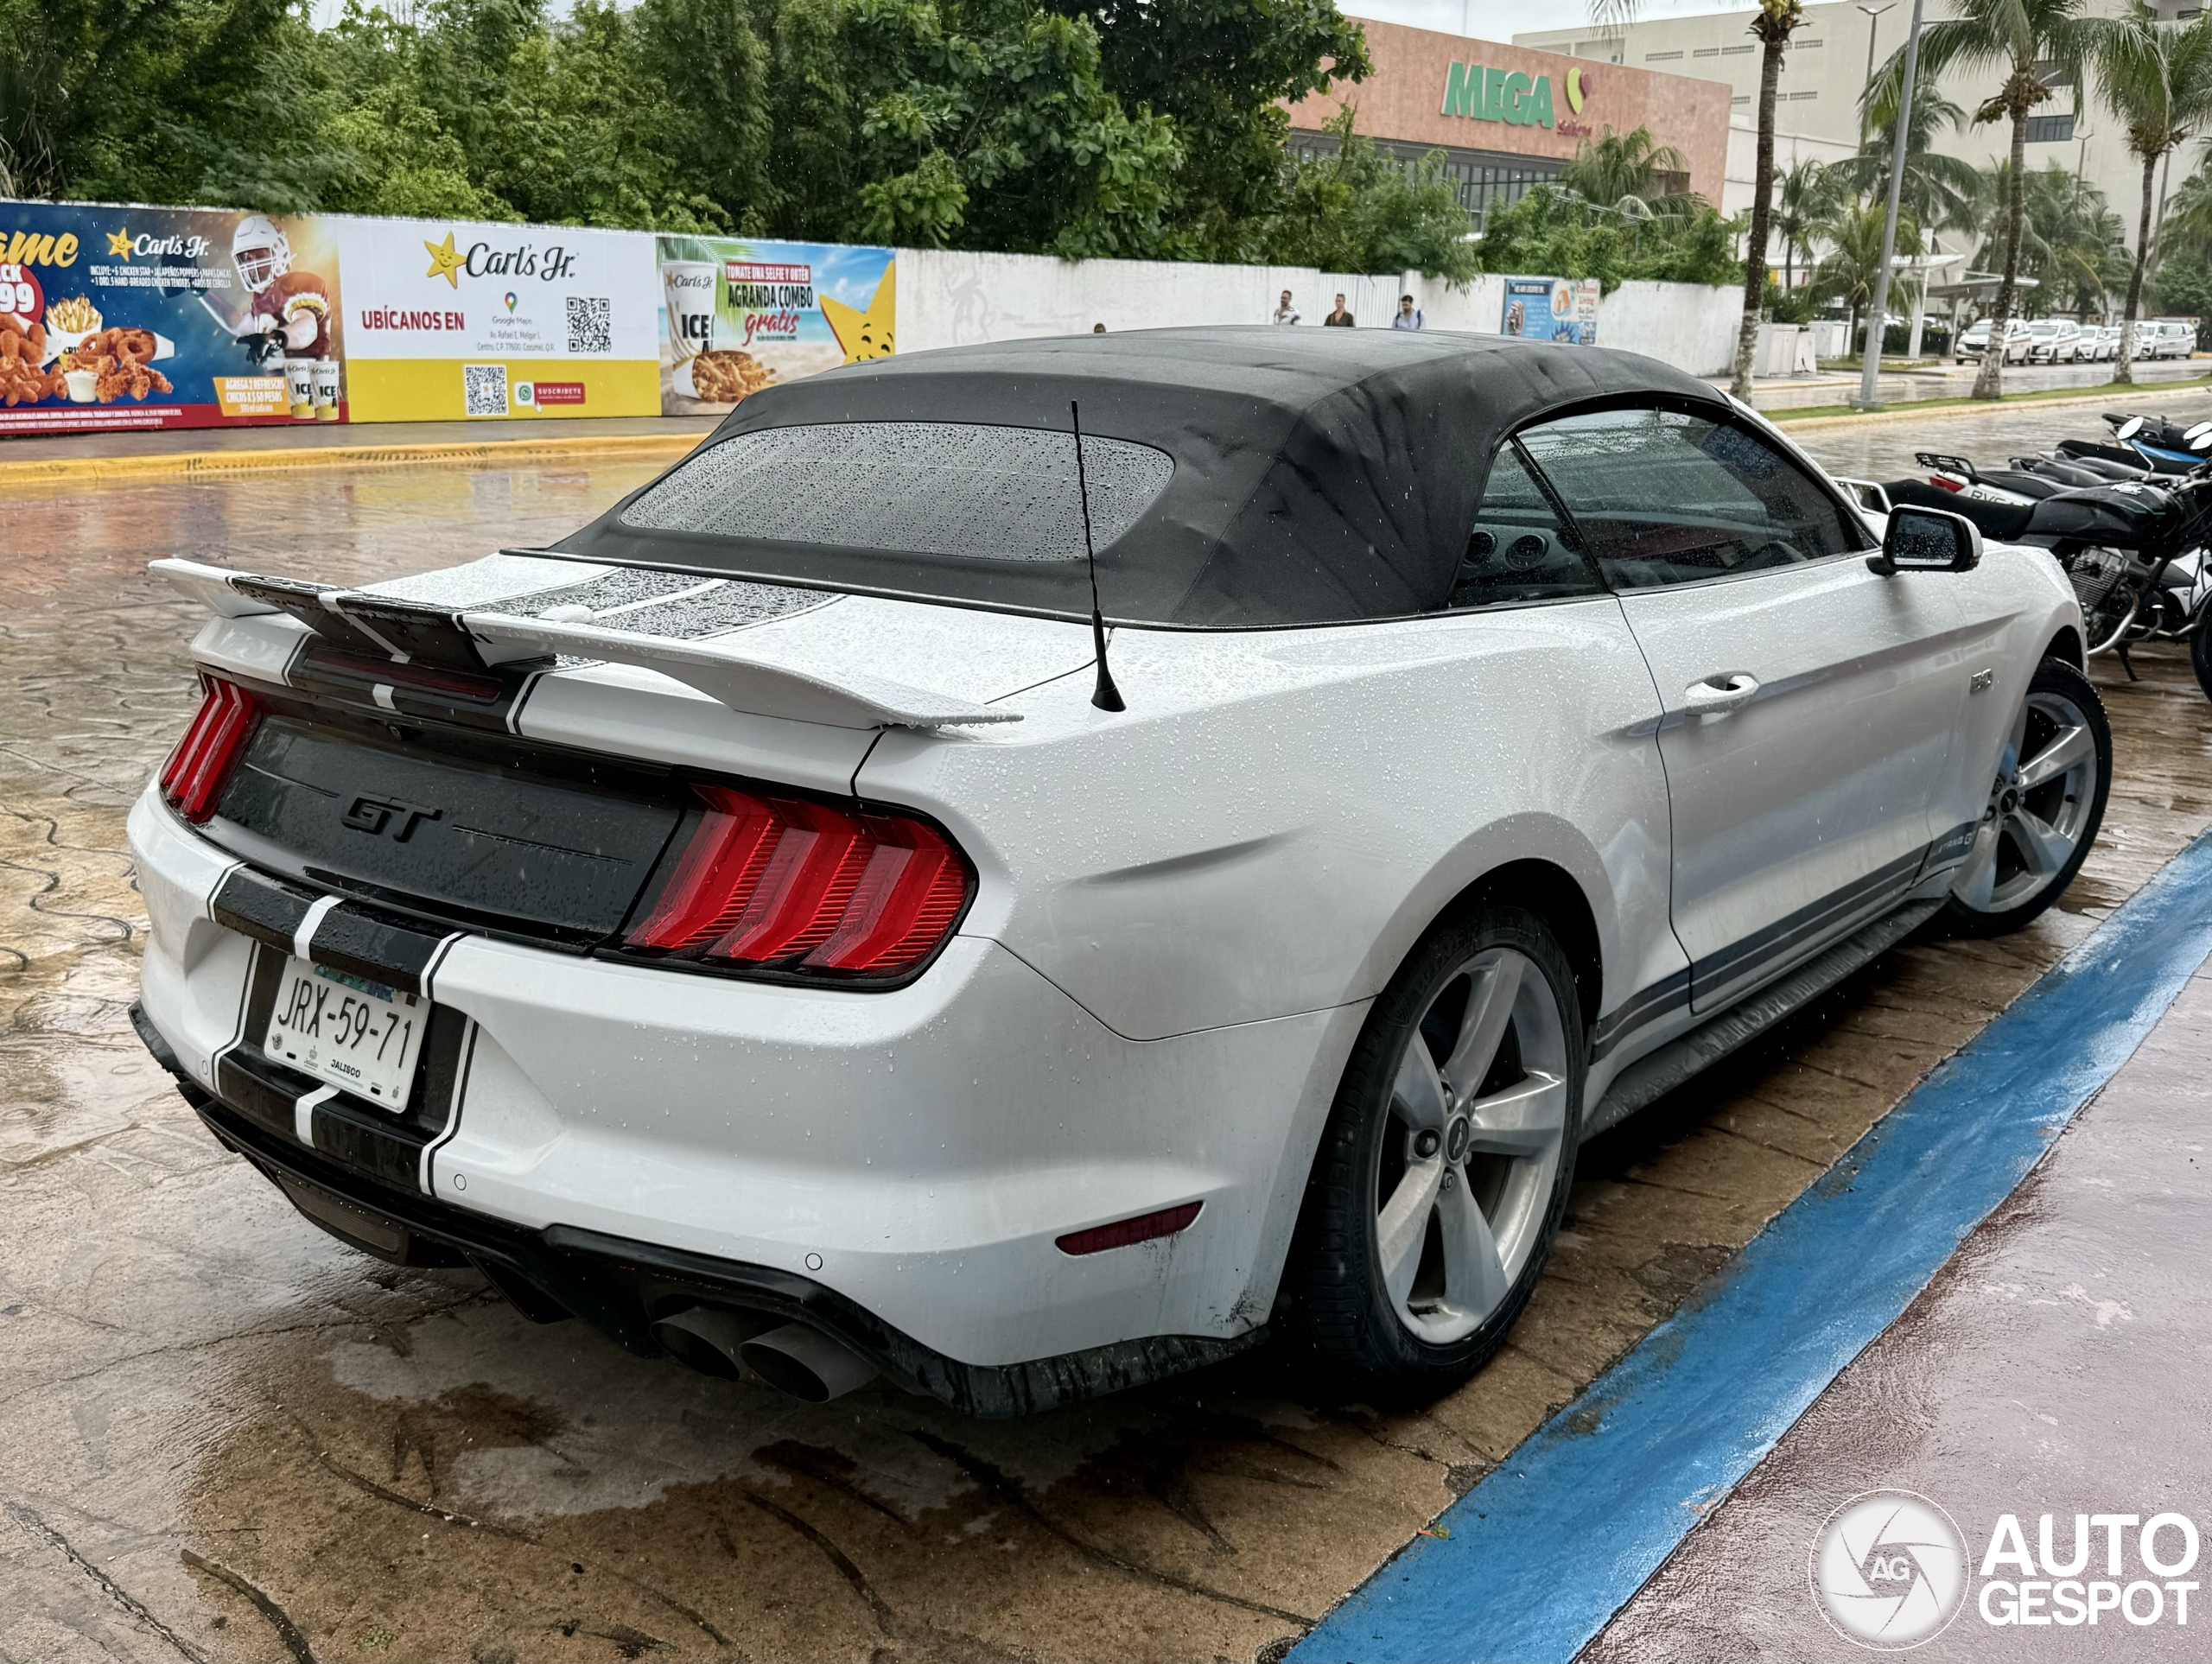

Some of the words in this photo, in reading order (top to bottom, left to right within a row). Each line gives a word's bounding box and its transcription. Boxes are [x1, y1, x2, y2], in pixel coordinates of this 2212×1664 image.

[1440, 61, 1555, 129] MEGA
[134, 233, 183, 257] Carl's
[184, 235, 210, 258] Jr.
[0, 264, 23, 283] CK
[466, 243, 537, 277] Carl's
[540, 246, 576, 282] Jr.
[727, 265, 752, 280] TOMATE
[752, 266, 765, 280] UNA
[765, 266, 785, 281] SELFIE
[675, 275, 702, 289] Carl's
[728, 285, 777, 308] AGRANDA
[779, 285, 814, 308] COMBO
[361, 305, 442, 331] UBÍCANOS
[444, 312, 465, 331] EN
[492, 315, 516, 326] Google
[517, 316, 533, 326] Maps
[682, 314, 710, 340] ICE
[741, 304, 800, 347] gratis
[320, 385, 336, 397] ICE
[340, 791, 443, 843] GT
[277, 977, 412, 1069] JRX-59-71
[331, 1058, 361, 1078] JALISCO
